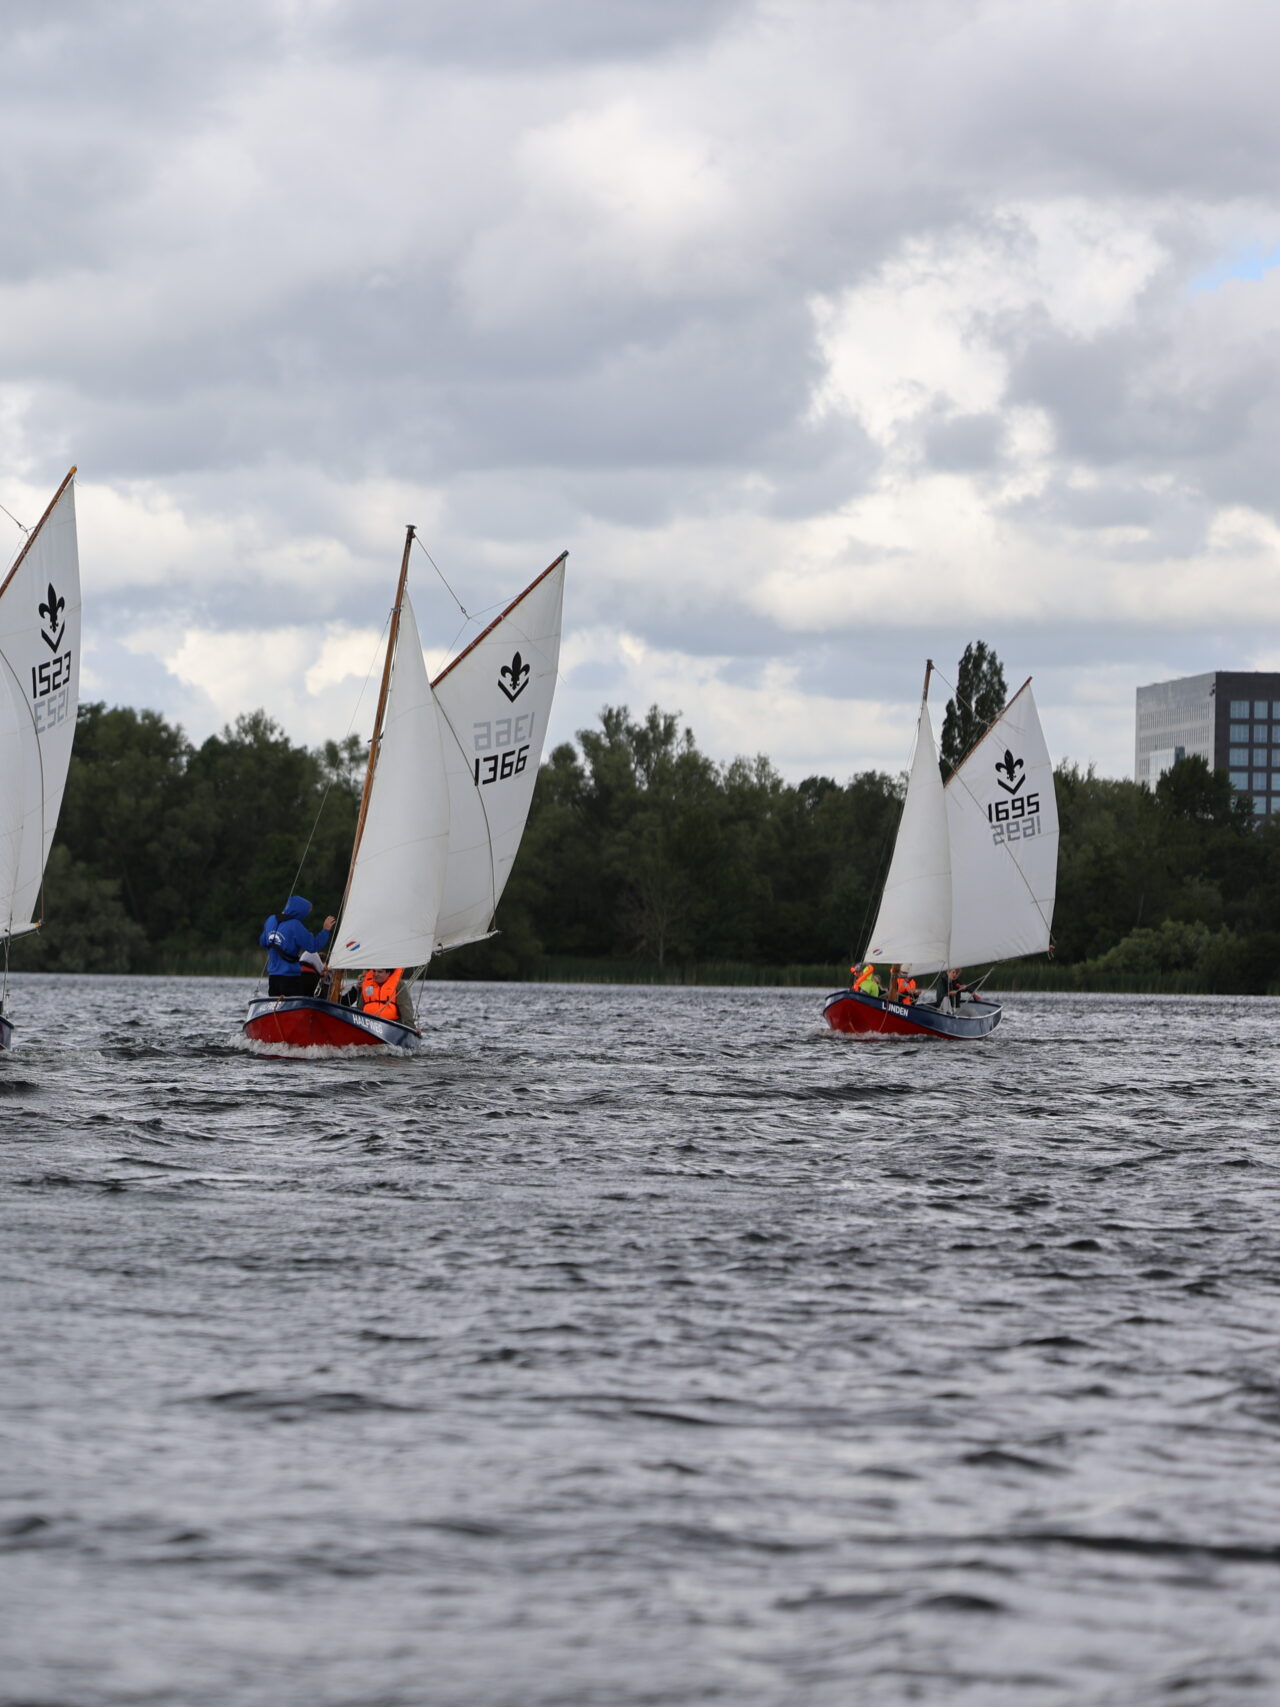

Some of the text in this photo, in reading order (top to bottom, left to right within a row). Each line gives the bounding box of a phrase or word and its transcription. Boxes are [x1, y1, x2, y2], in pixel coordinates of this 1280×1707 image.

[32, 650, 71, 699] 1523
[474, 744, 530, 786] 1366
[988, 792, 1039, 823] 1695
